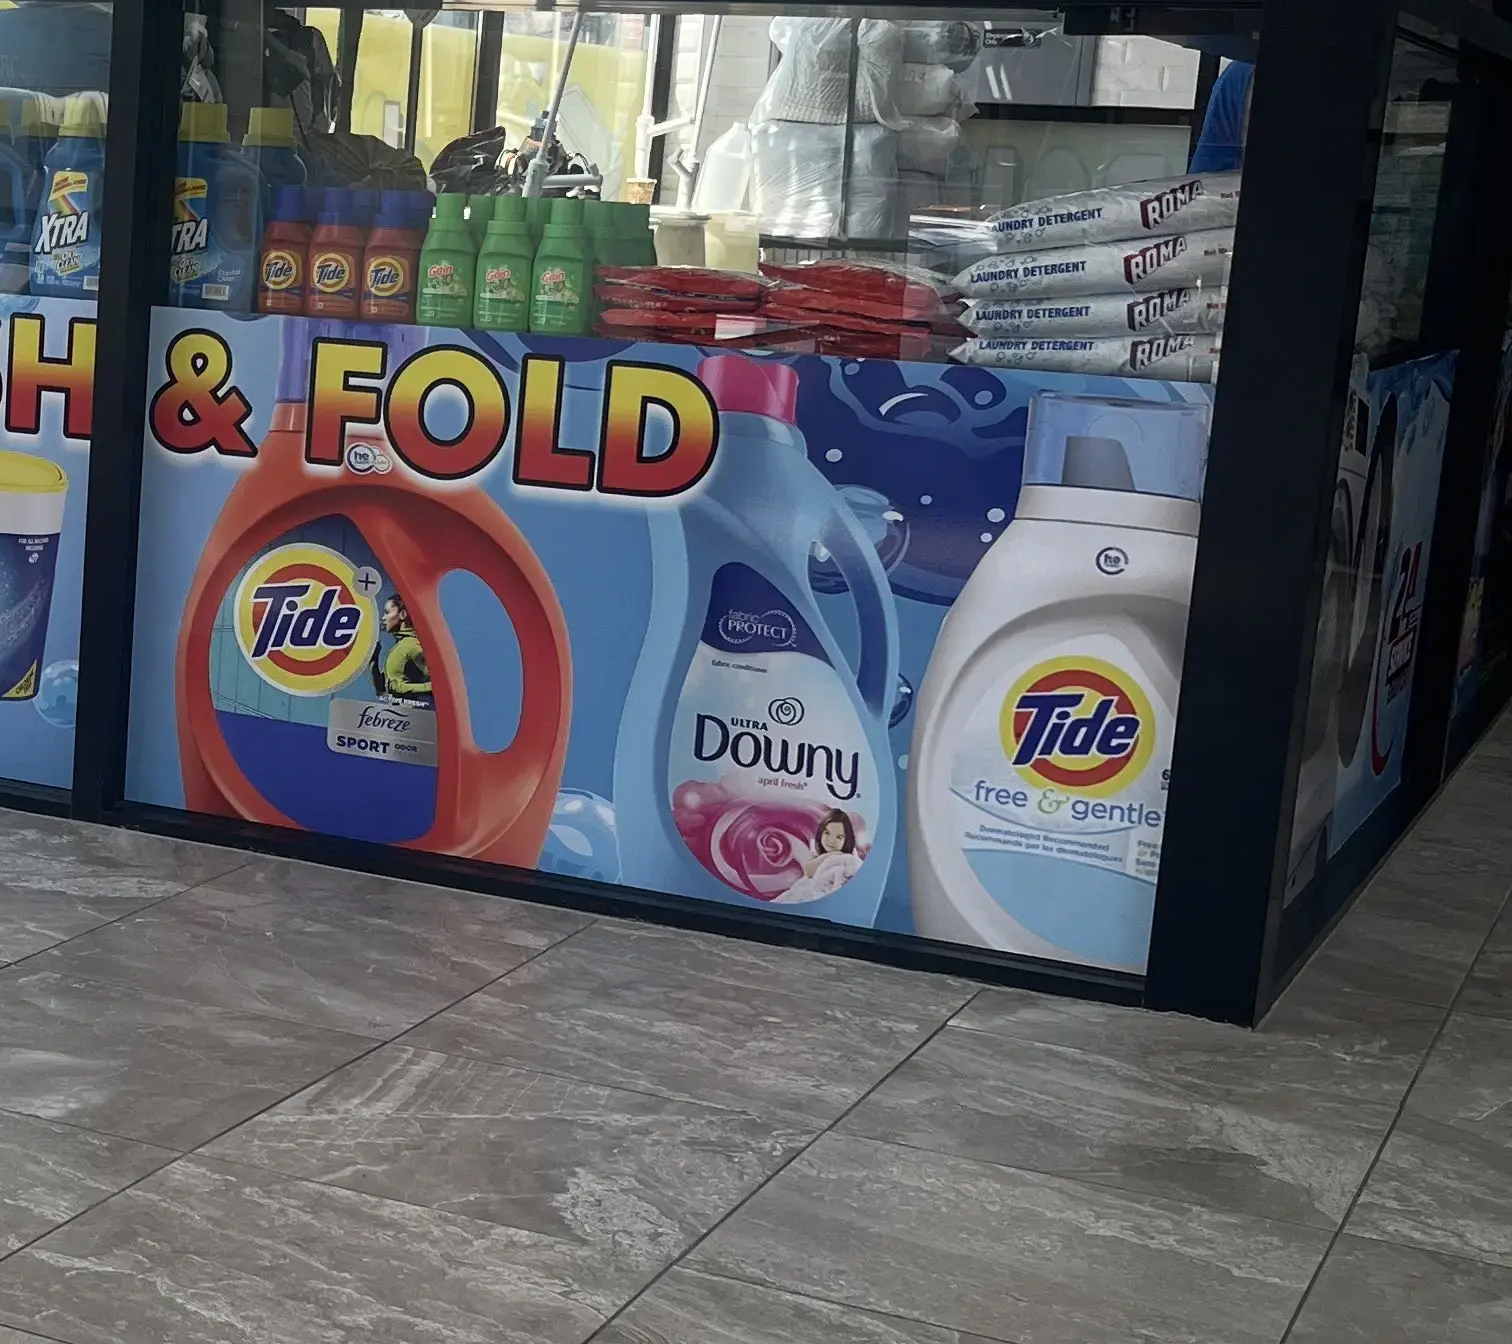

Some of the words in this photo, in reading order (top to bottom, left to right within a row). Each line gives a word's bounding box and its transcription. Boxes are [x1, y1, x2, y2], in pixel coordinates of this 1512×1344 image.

[1140, 179, 1205, 230] ROMA
[1037, 207, 1103, 227] DETERGENT
[34, 211, 89, 254] XTRA
[428, 264, 453, 278] Gain
[1123, 235, 1187, 285] ROMA
[265, 261, 292, 282] Tide
[317, 264, 345, 285] Tide
[370, 268, 399, 289] Tide
[486, 269, 511, 281] Gain
[541, 271, 565, 282] Gain
[970, 267, 1019, 284] LAUNDRY
[1023, 260, 1087, 278] DETERGENT
[975, 309, 1025, 321] LAUNDRY
[1027, 305, 1091, 319] DETERGENT
[1127, 287, 1191, 332] ROMA
[979, 340, 1029, 351] LAUNDRY
[1031, 340, 1094, 351] DETERGENT
[1129, 334, 1196, 372] ROMA
[149, 327, 258, 458] &
[304, 337, 720, 498] FOLD
[250, 583, 362, 659] Tide
[728, 608, 760, 623] fabric
[727, 618, 789, 640] PROTECT
[356, 704, 412, 733] febreze
[730, 716, 769, 732] ULTRA
[1013, 692, 1141, 767] Tide
[336, 735, 391, 754] SPORT
[394, 742, 418, 753] ODOR
[693, 712, 861, 801] Downy
[757, 776, 779, 787] april
[974, 778, 1028, 809] free
[1036, 790, 1071, 815] &
[1071, 794, 1162, 828] gentle
[979, 823, 1041, 841] Dermatologist
[1042, 834, 1110, 852] Recommended
